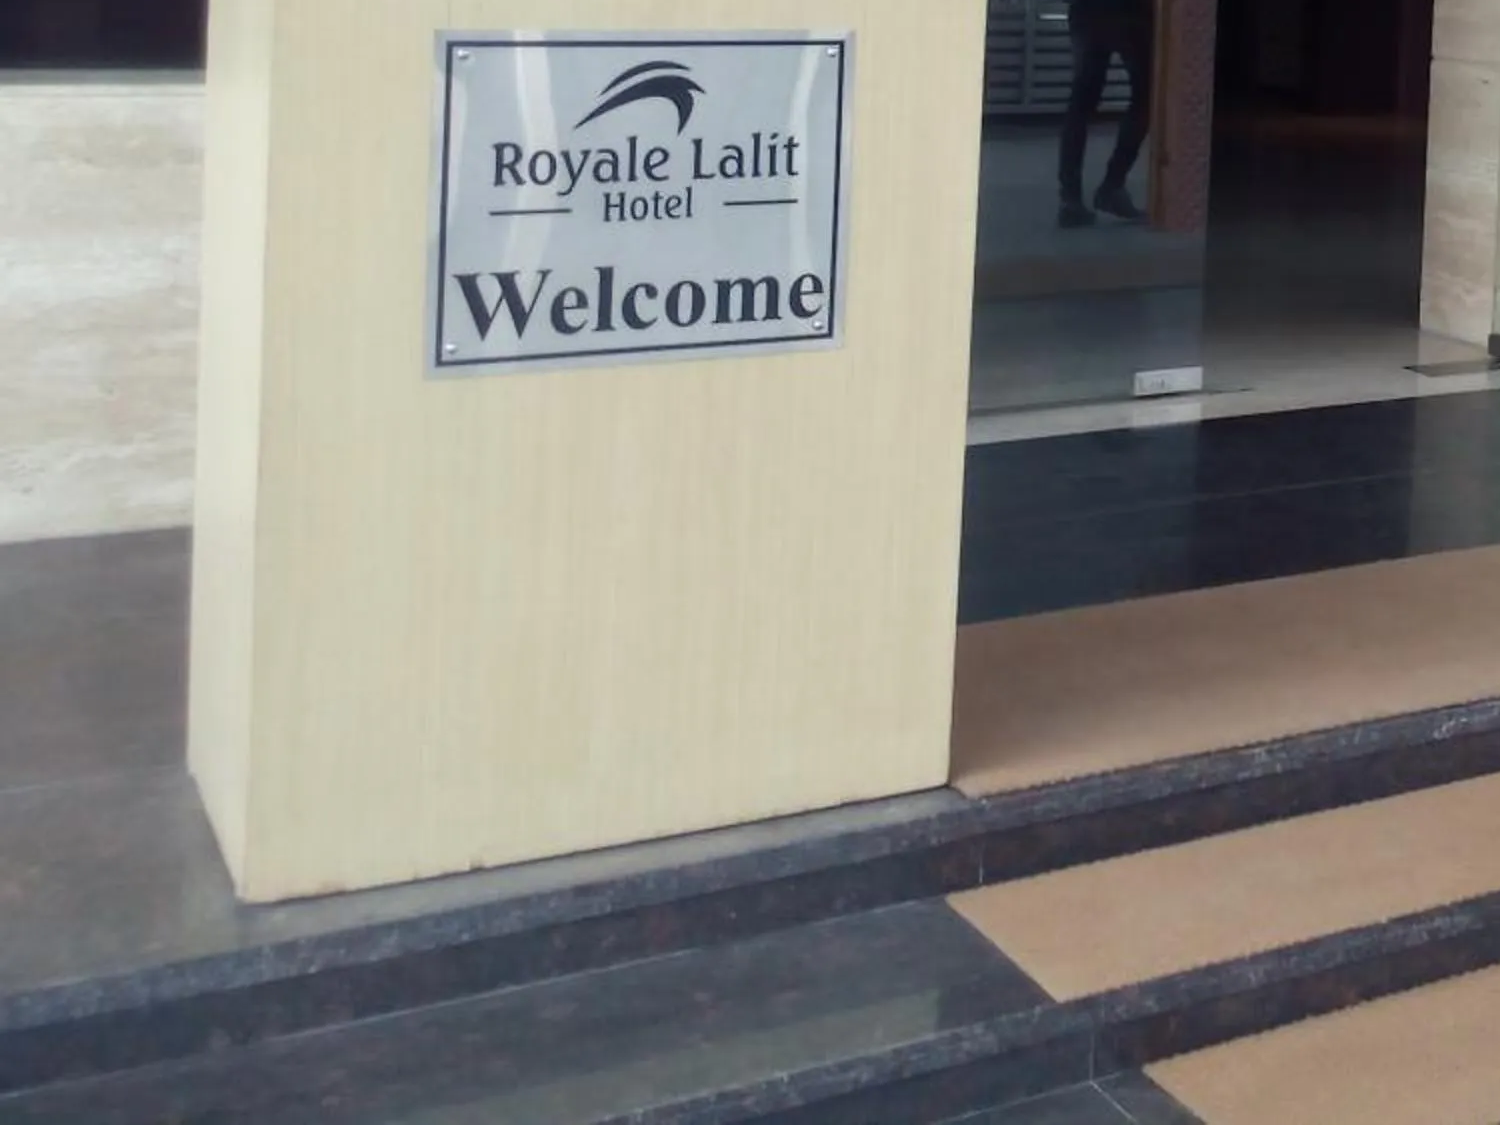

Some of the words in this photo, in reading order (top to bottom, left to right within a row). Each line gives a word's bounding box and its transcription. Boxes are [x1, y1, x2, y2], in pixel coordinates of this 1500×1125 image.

[492, 136, 671, 196] Royale
[691, 131, 801, 180] Lalit
[602, 186, 694, 222] Hotel
[452, 266, 825, 341] Welcome
